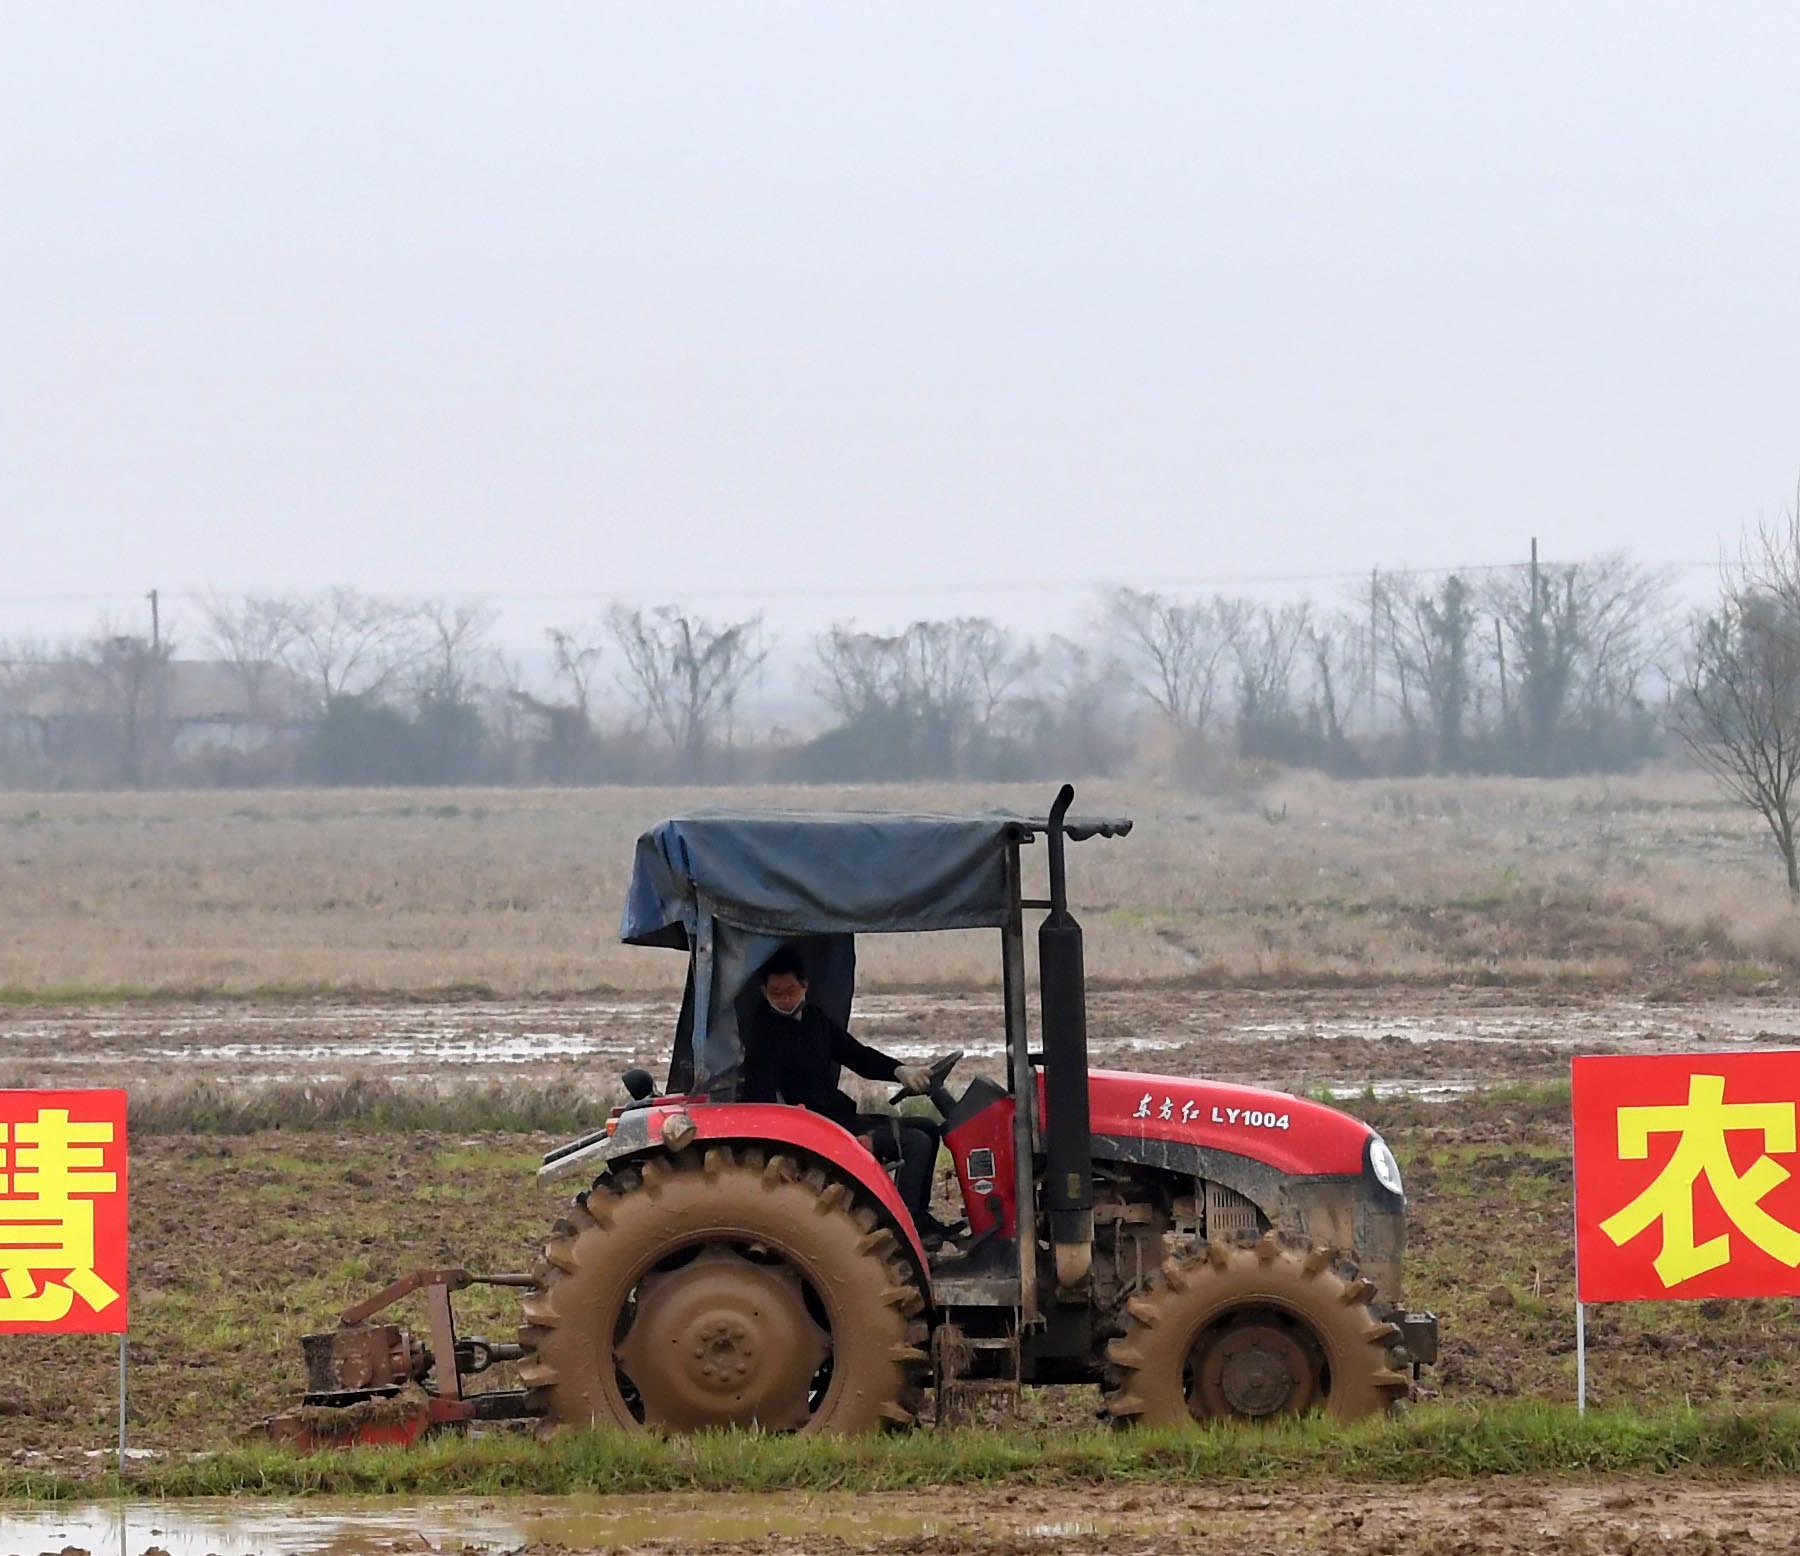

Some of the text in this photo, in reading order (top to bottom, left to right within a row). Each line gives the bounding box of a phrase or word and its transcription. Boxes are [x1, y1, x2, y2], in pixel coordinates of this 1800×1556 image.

[1132, 1092, 1290, 1130] 东方红 LY1004
